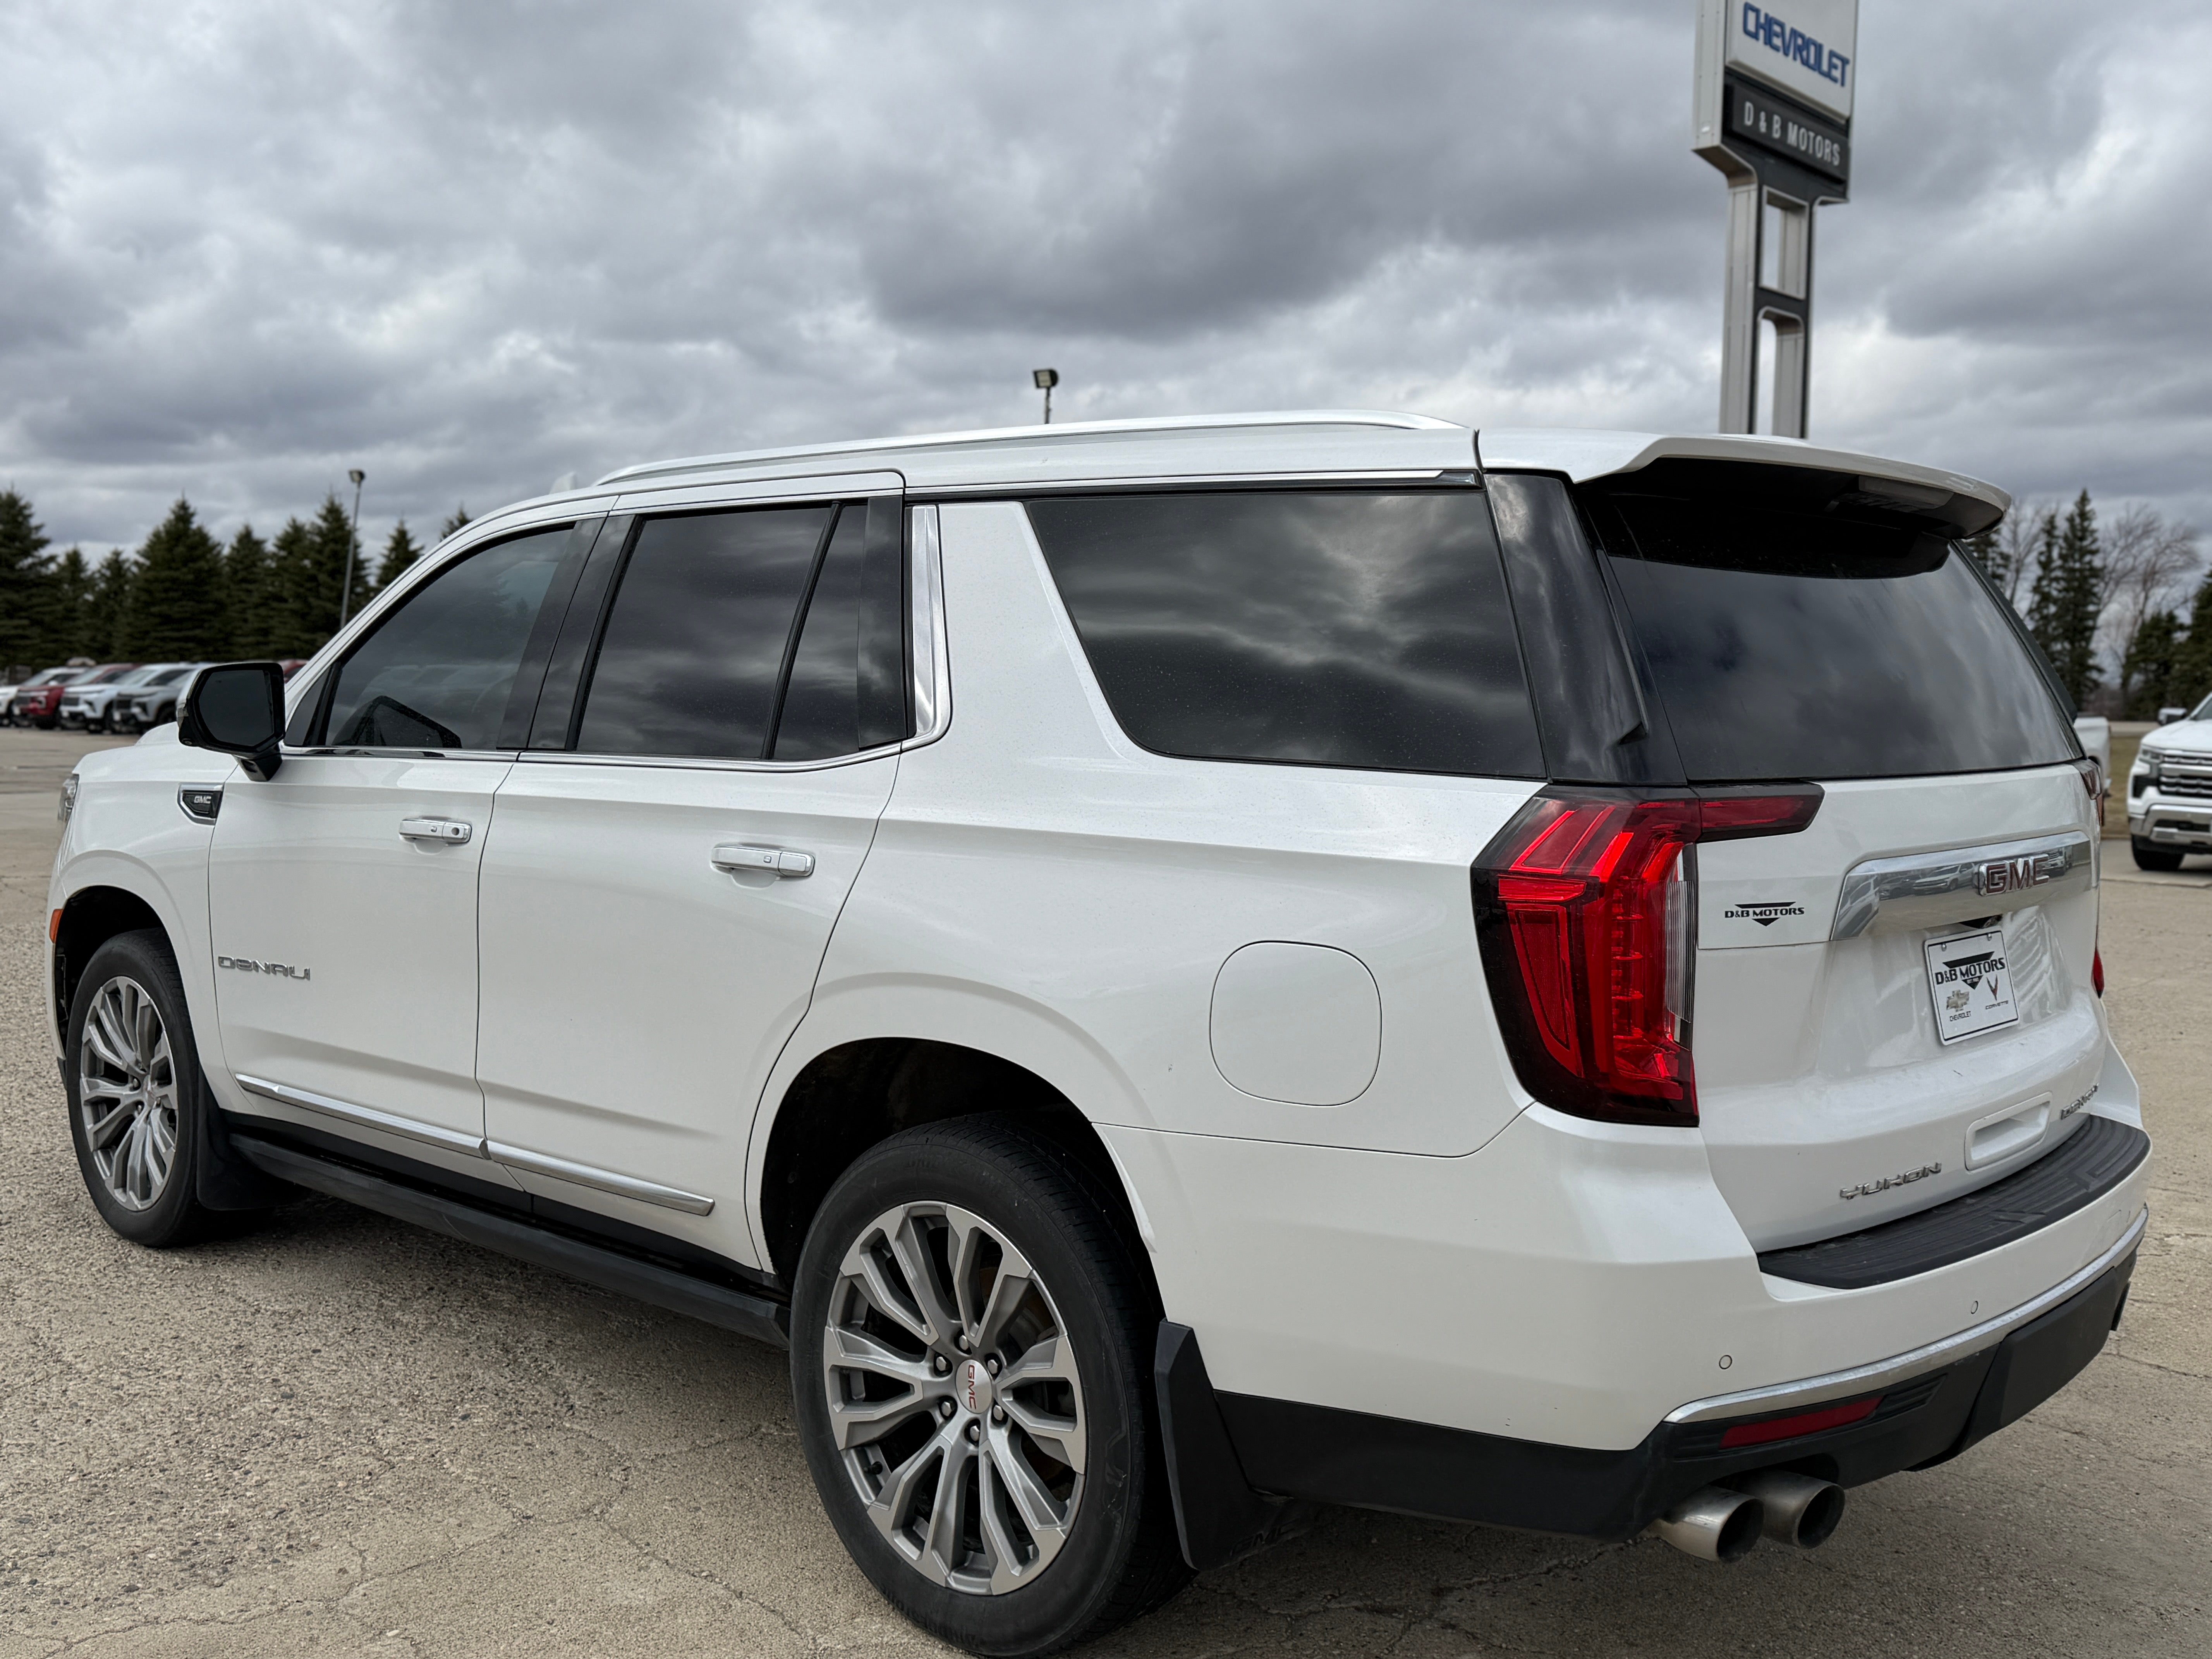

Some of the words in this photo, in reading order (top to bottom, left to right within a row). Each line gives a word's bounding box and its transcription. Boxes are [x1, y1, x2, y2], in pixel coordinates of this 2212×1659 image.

[1743, 1, 1850, 87] CHEVROLET
[1744, 101, 1754, 126] D
[1759, 111, 1767, 132] &
[1772, 114, 1781, 139] B
[1787, 121, 1841, 167] MOTORS
[194, 795, 212, 804] GMC
[1979, 854, 2050, 896] GMC
[1724, 909, 1750, 918] D&B
[1753, 907, 1805, 917] MOTORS
[218, 955, 311, 981] DENALI
[1935, 969, 1958, 985] D&B
[1960, 957, 2006, 980] MOTORS
[1840, 1162, 1942, 1199] YUKON
[968, 1364, 977, 1410] GMC
